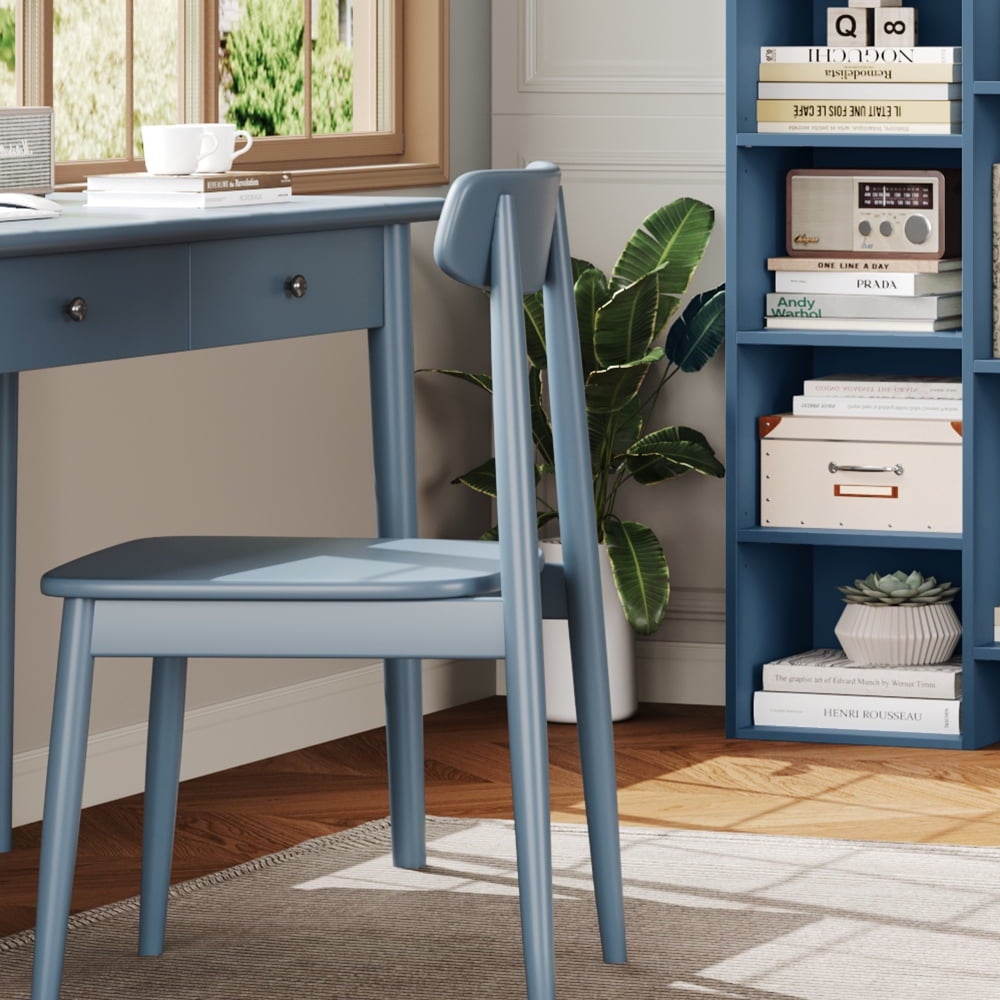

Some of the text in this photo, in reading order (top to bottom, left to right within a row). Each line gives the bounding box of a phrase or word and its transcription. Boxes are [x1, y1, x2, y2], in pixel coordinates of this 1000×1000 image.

[835, 14, 857, 38] Q
[808, 48, 915, 63] NOGUCHI
[825, 69, 893, 80] Remodelista
[793, 105, 815, 119] CAFÉ
[816, 106, 827, 117] LE
[828, 106, 848, 117] FOIS
[849, 106, 867, 117] UNE
[893, 106, 902, 117] IL
[857, 279, 898, 289] PRADA
[777, 297, 815, 311] Andy
[771, 308, 822, 318] Warhol
[788, 675, 812, 684] graphic
[832, 677, 856, 685] Edvard
[857, 678, 880, 686] Munch
[881, 679, 889, 688] by
[891, 680, 915, 688] Werner
[823, 708, 922, 721] HENRI ROUSSEAU
